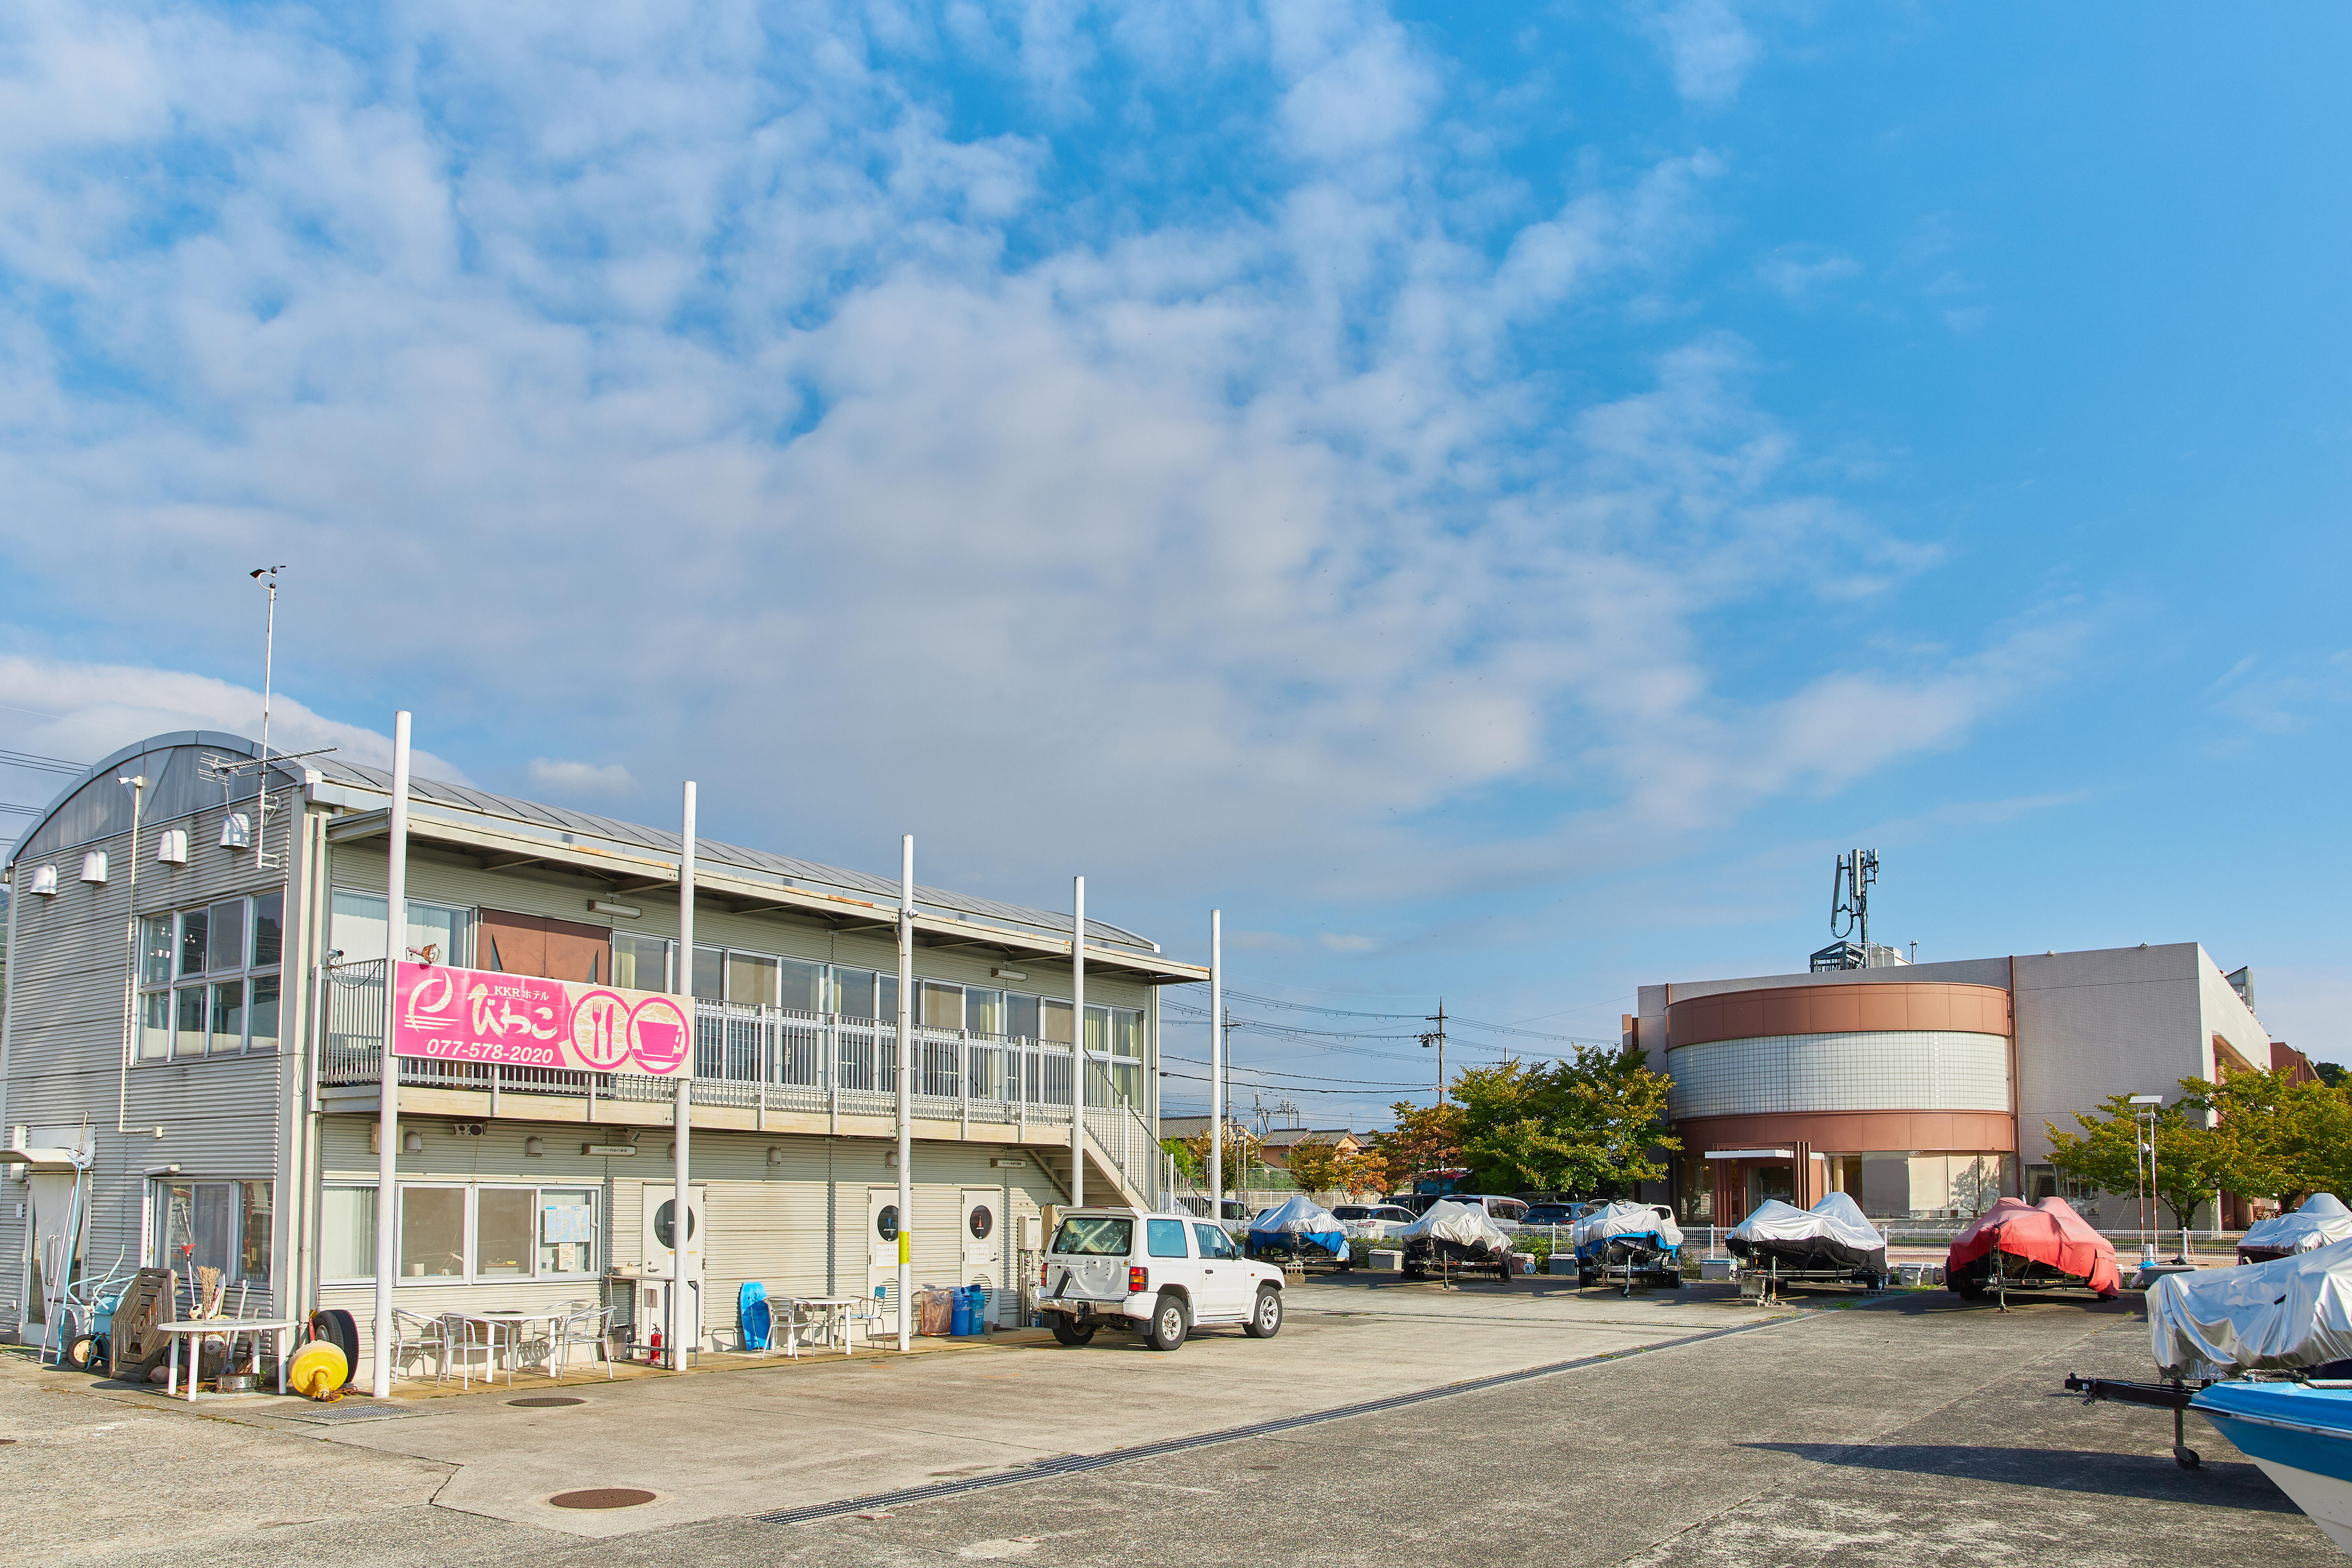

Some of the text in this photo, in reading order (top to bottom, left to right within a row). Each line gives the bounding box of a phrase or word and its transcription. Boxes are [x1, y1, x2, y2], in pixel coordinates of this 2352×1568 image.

[494, 986, 549, 1001] KKR ホテル
[467, 983, 557, 1040] びわこ
[426, 1038, 554, 1064] 077-578-2020
